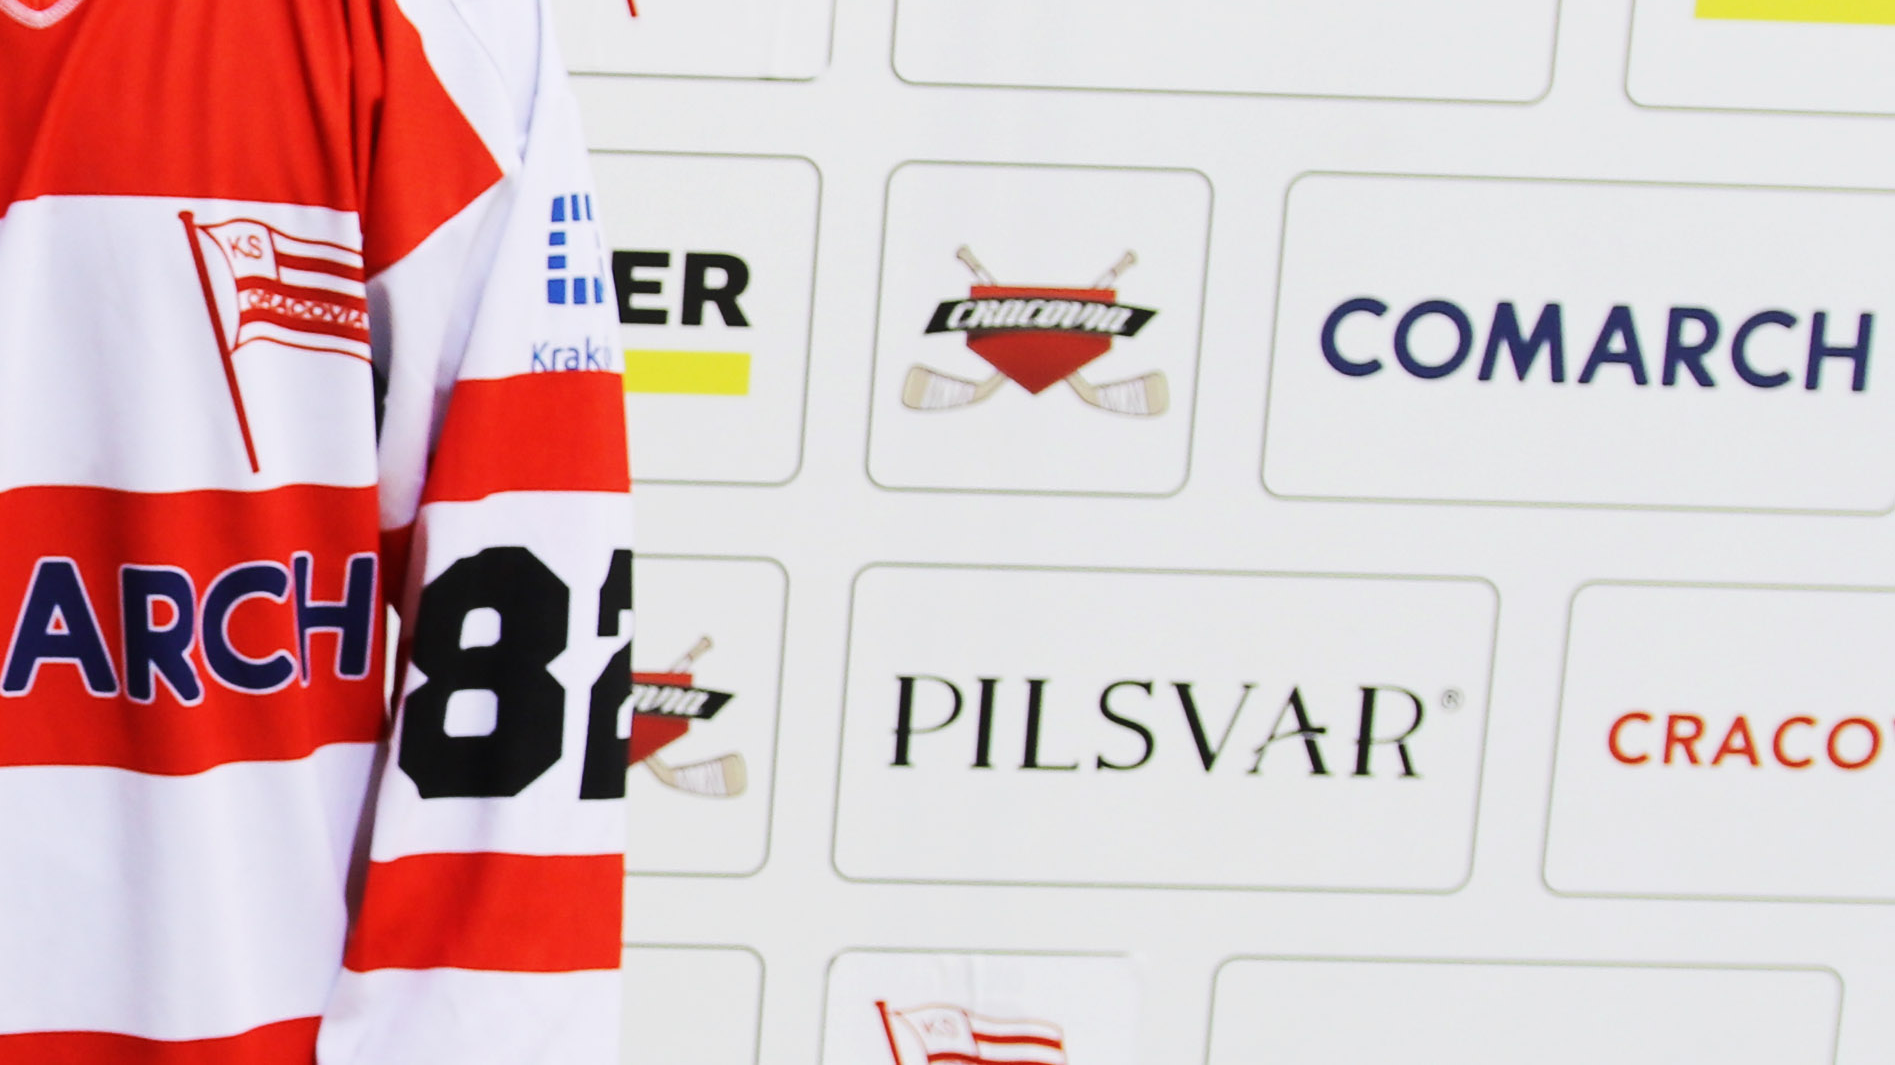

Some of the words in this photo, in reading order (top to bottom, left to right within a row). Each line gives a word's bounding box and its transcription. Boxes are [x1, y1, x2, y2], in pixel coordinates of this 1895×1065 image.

[228, 234, 263, 259] KS
[249, 288, 367, 330] CRACOVIA
[1320, 297, 1875, 393] COMARCH
[1607, 710, 1895, 772] CRACO
